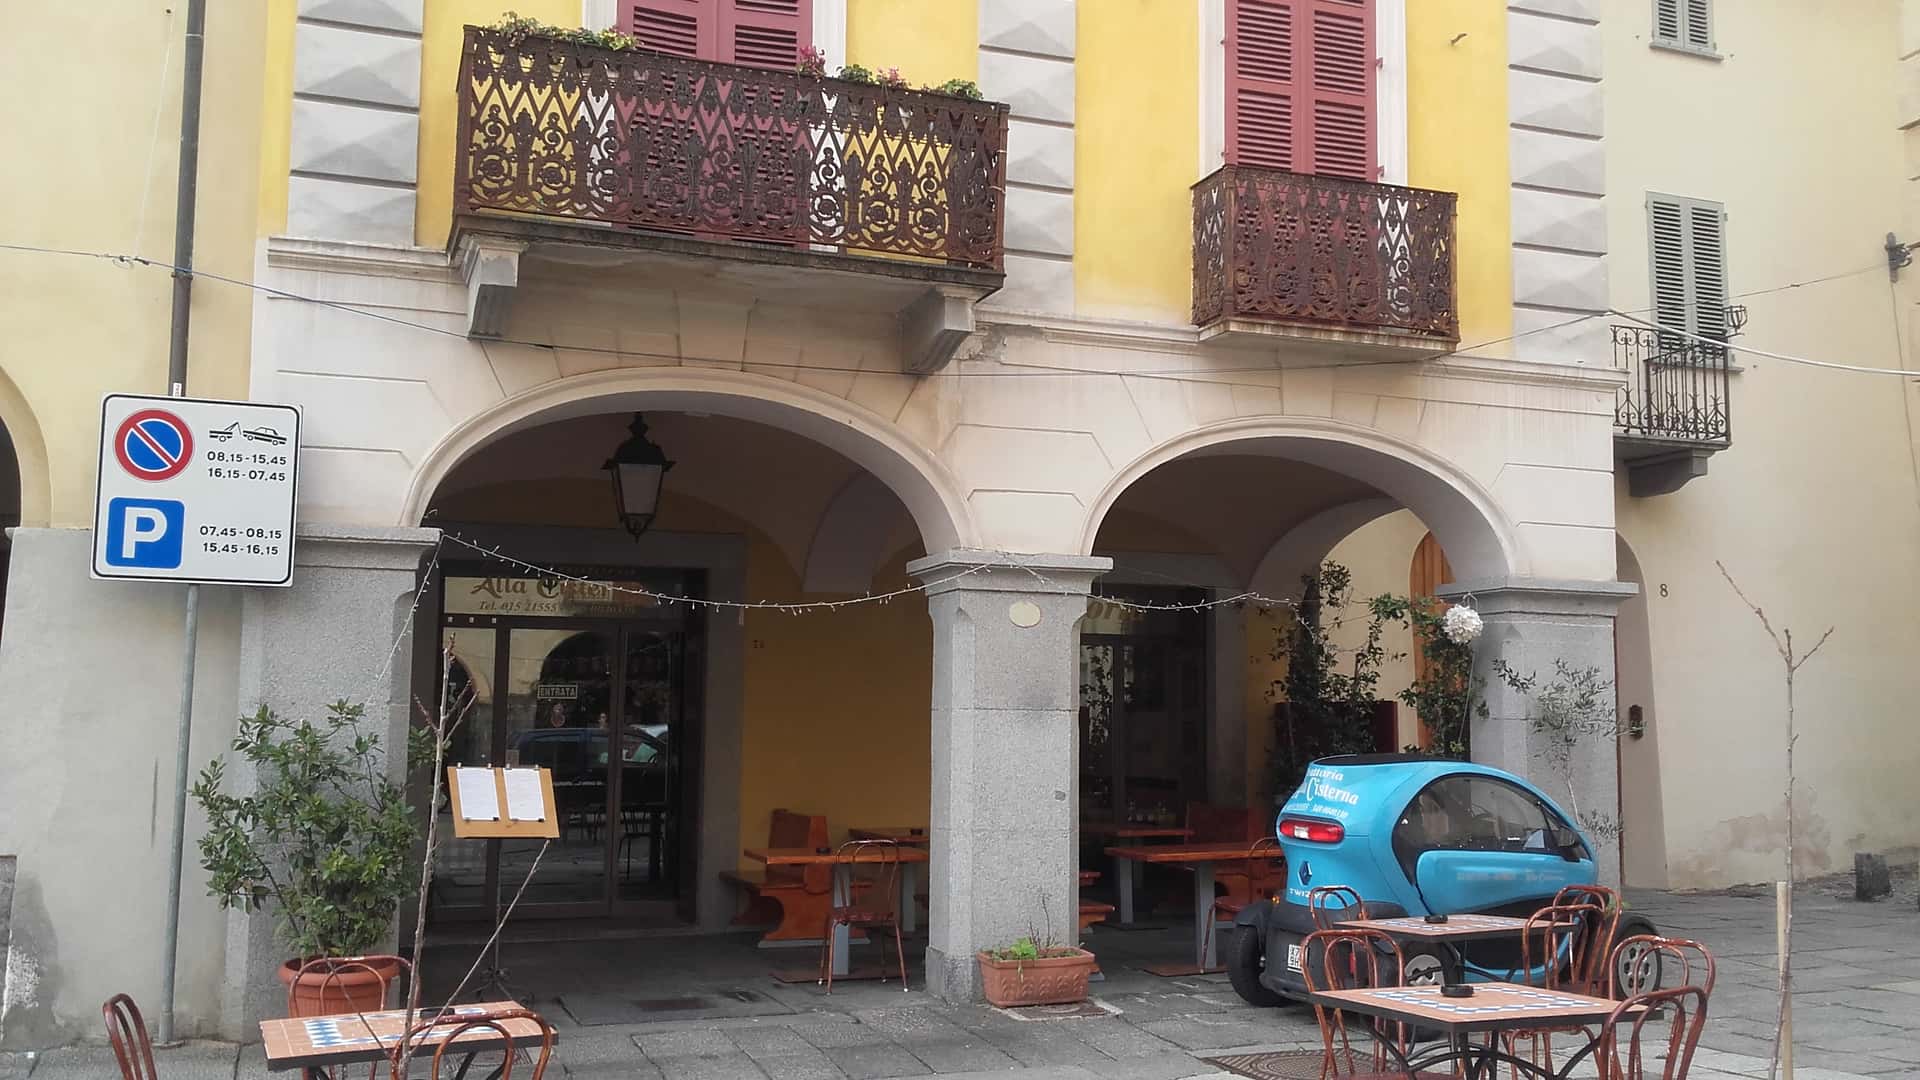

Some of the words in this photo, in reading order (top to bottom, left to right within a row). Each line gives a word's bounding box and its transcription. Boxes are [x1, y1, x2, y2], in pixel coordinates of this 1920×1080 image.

[122, 506, 168, 559] P
[471, 577, 526, 598] Alla
[1659, 583, 1669, 598] 8
[479, 600, 497, 611] Tel.
[540, 687, 576, 697] ENTRATA
[1306, 777, 1359, 805] Cisterna
